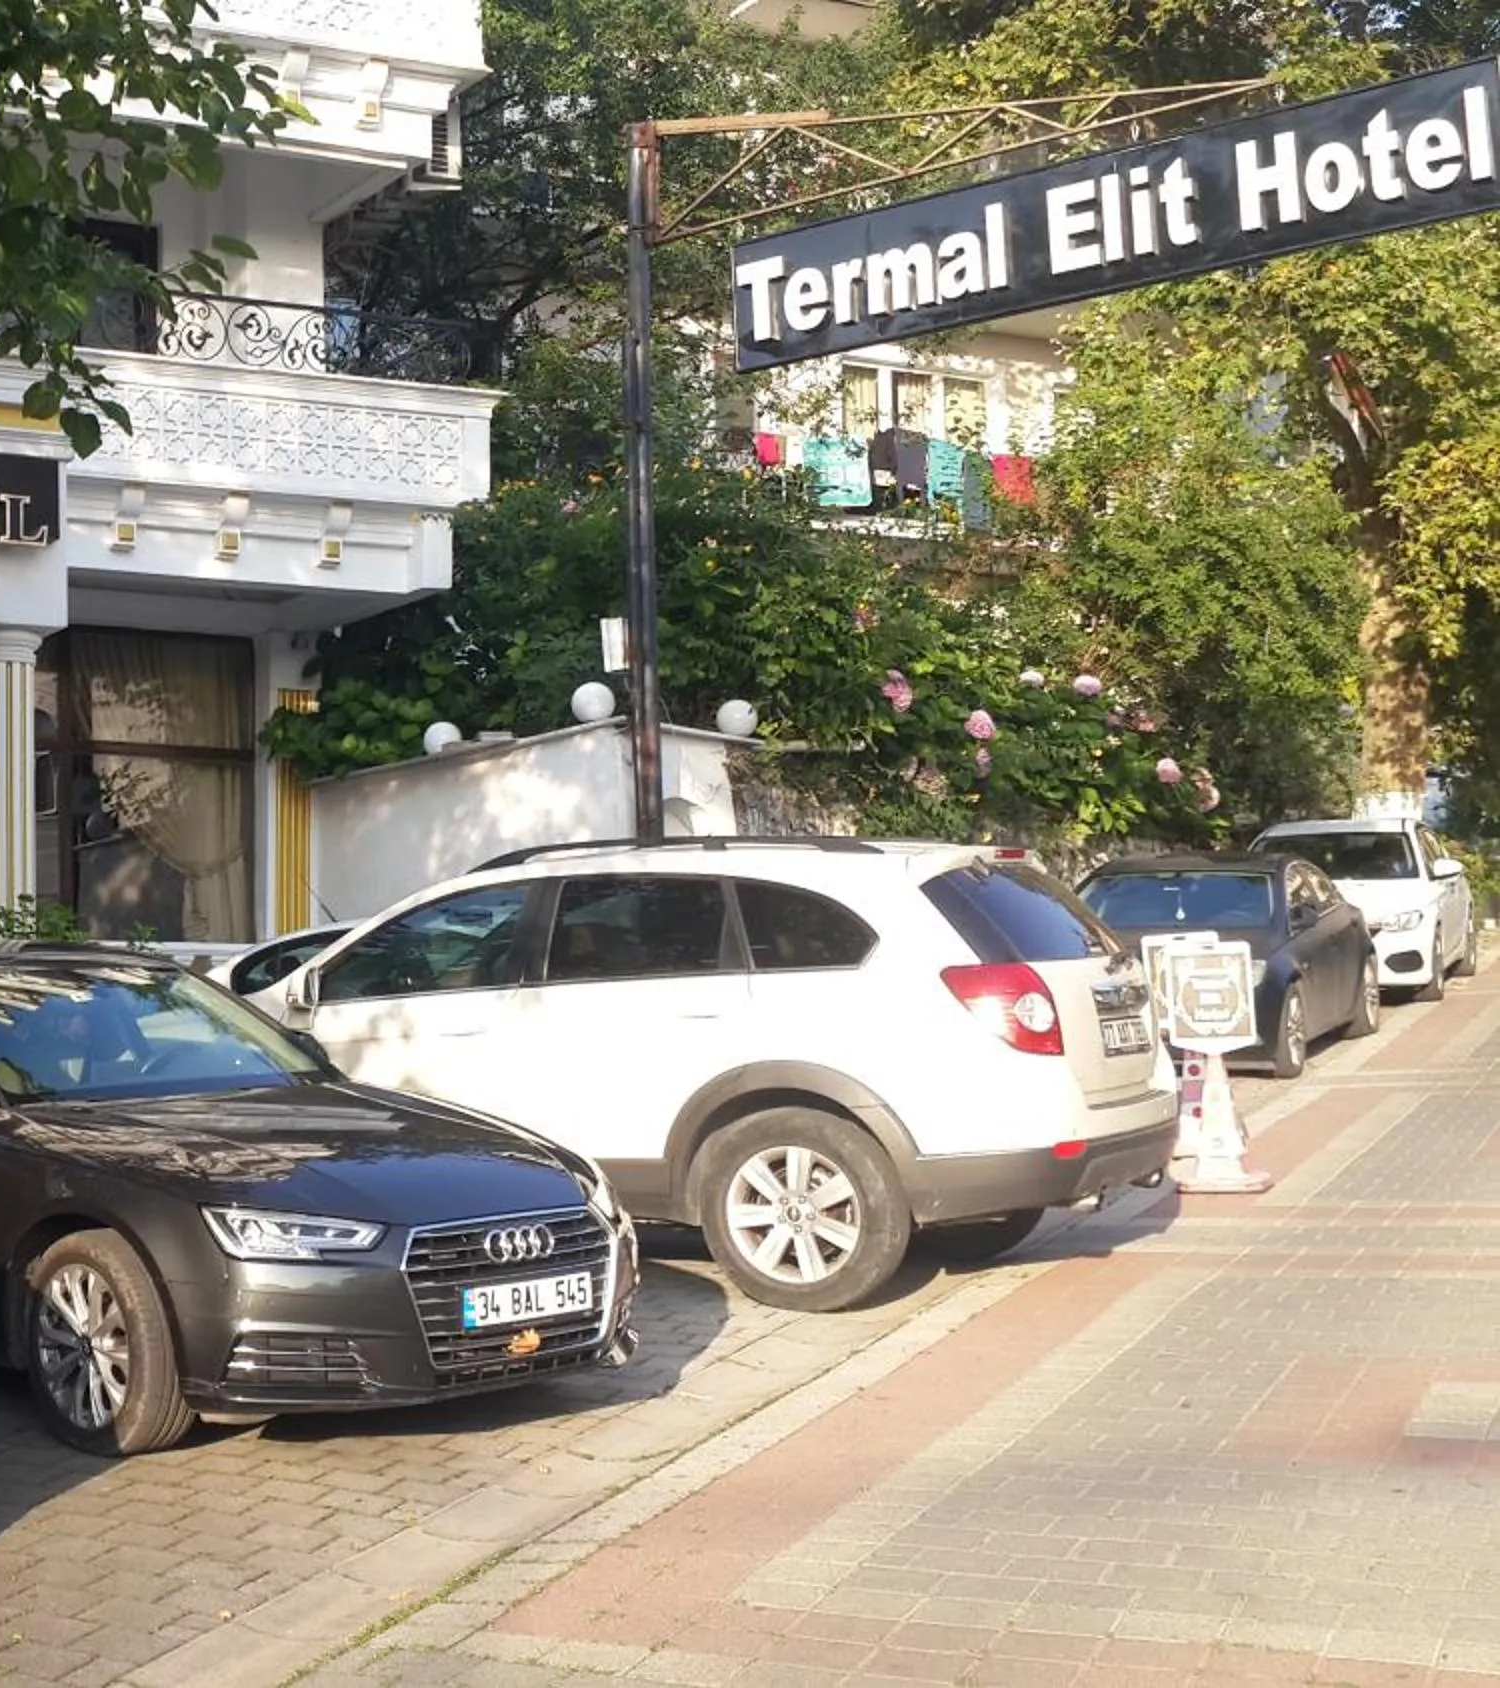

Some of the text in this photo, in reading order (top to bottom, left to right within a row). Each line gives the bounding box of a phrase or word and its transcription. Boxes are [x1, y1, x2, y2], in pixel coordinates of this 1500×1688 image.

[736, 86, 1493, 343] Termal Elit Hotel
[478, 1289, 500, 1320] 34
[512, 1285, 544, 1315] BAL
[556, 1277, 587, 1308] 545
